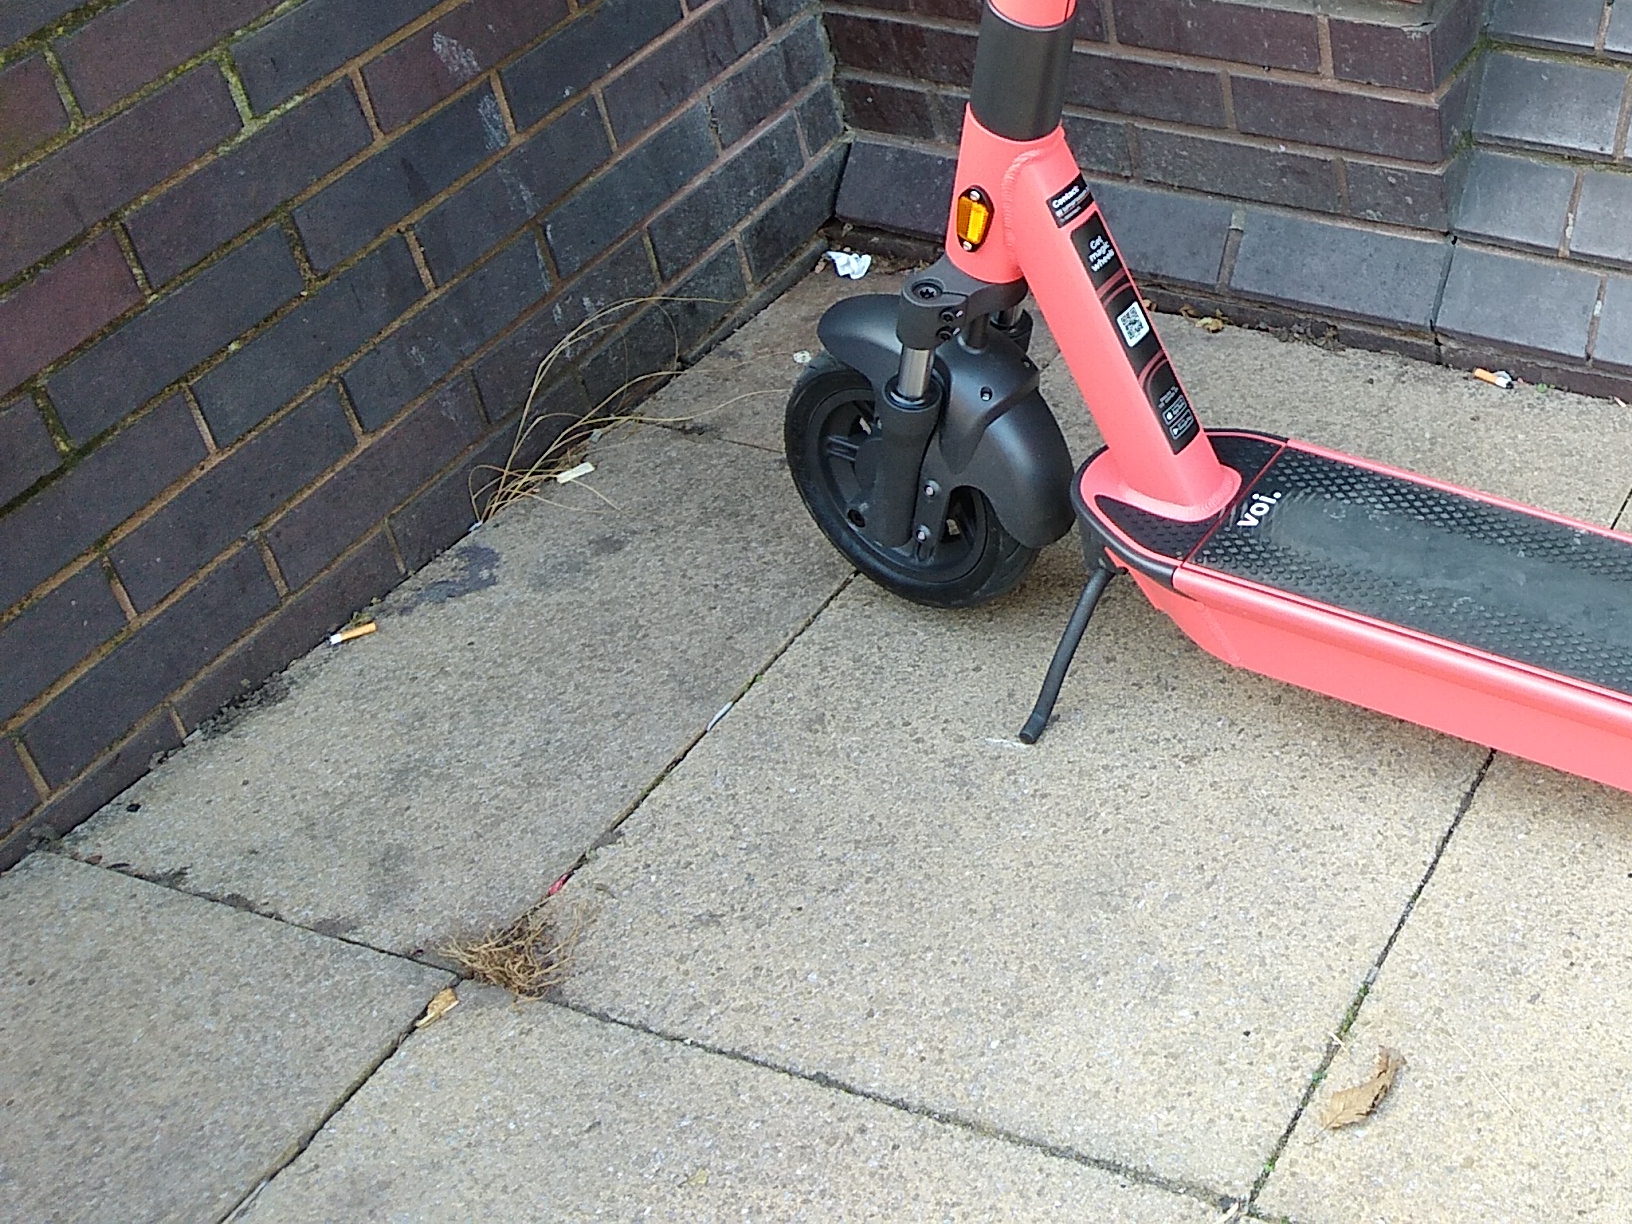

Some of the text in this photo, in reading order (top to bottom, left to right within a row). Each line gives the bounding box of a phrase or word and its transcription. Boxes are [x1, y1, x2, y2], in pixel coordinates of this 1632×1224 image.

[1051, 185, 1080, 210] Contact
[1088, 240, 1111, 264] magic
[1235, 491, 1282, 527] voi.
